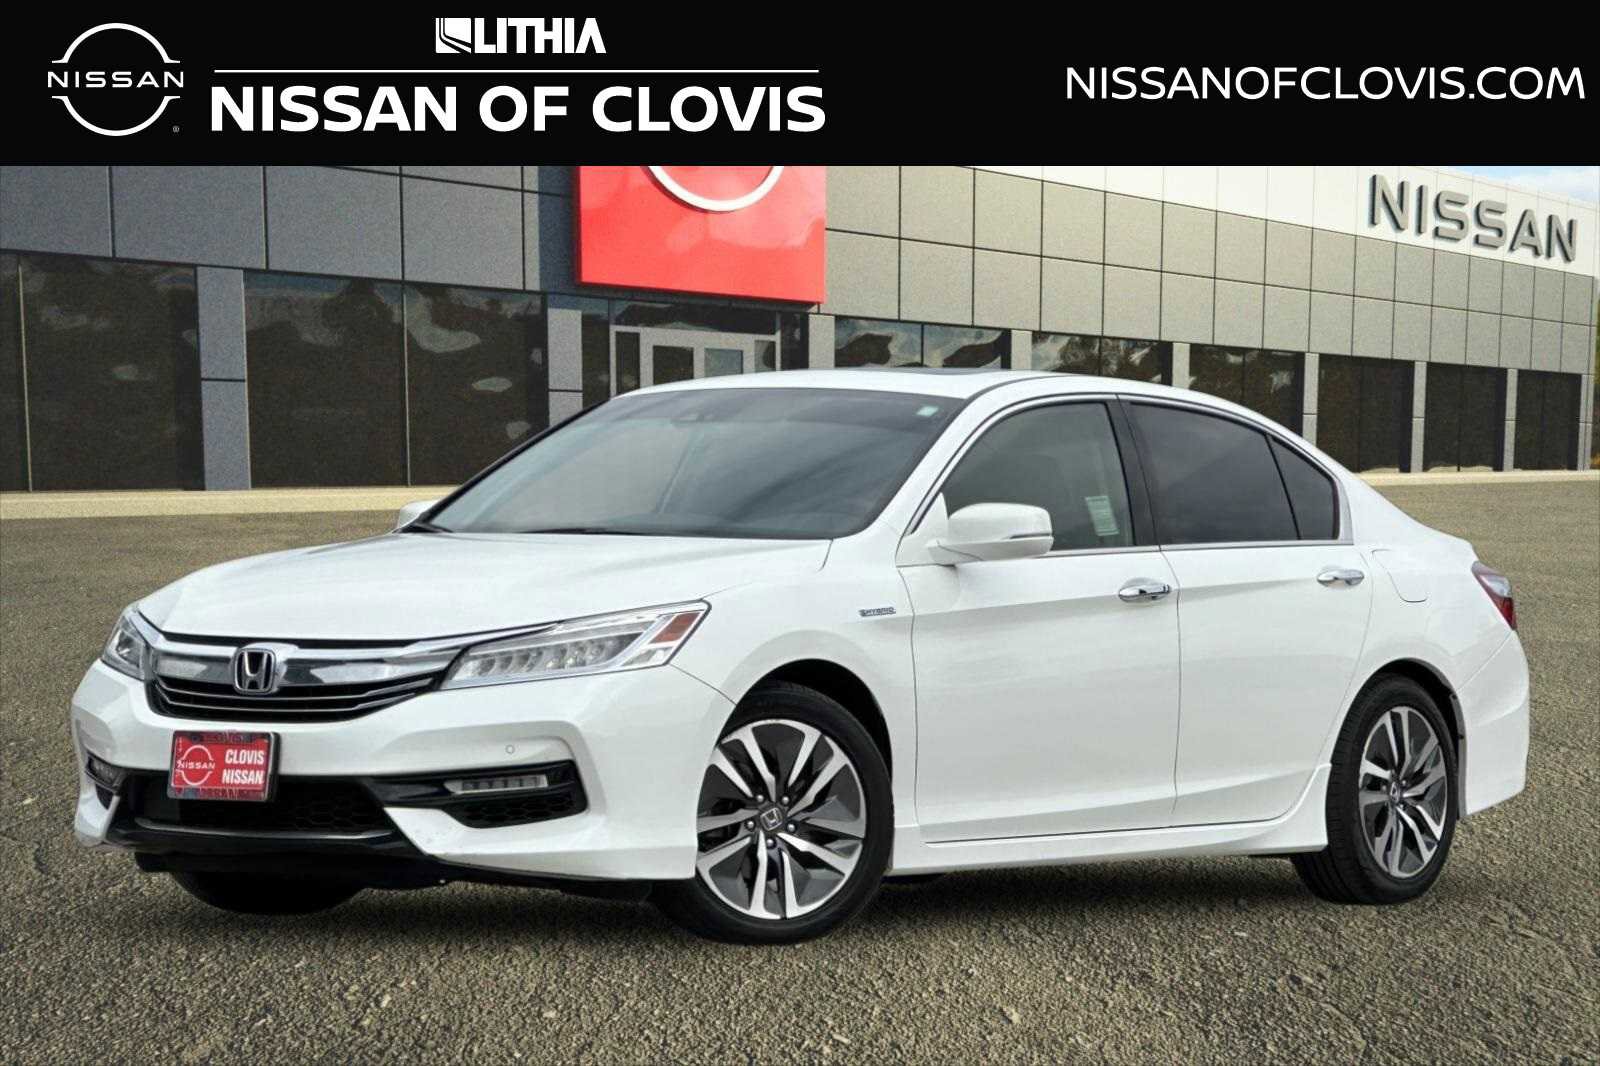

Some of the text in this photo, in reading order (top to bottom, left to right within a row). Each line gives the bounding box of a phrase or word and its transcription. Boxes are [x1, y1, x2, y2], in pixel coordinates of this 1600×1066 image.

[1369, 174, 1577, 262] NISSAN
[177, 760, 216, 770] NISSAN
[224, 748, 265, 766] CLOVIS
[221, 768, 265, 785] NISSAN
